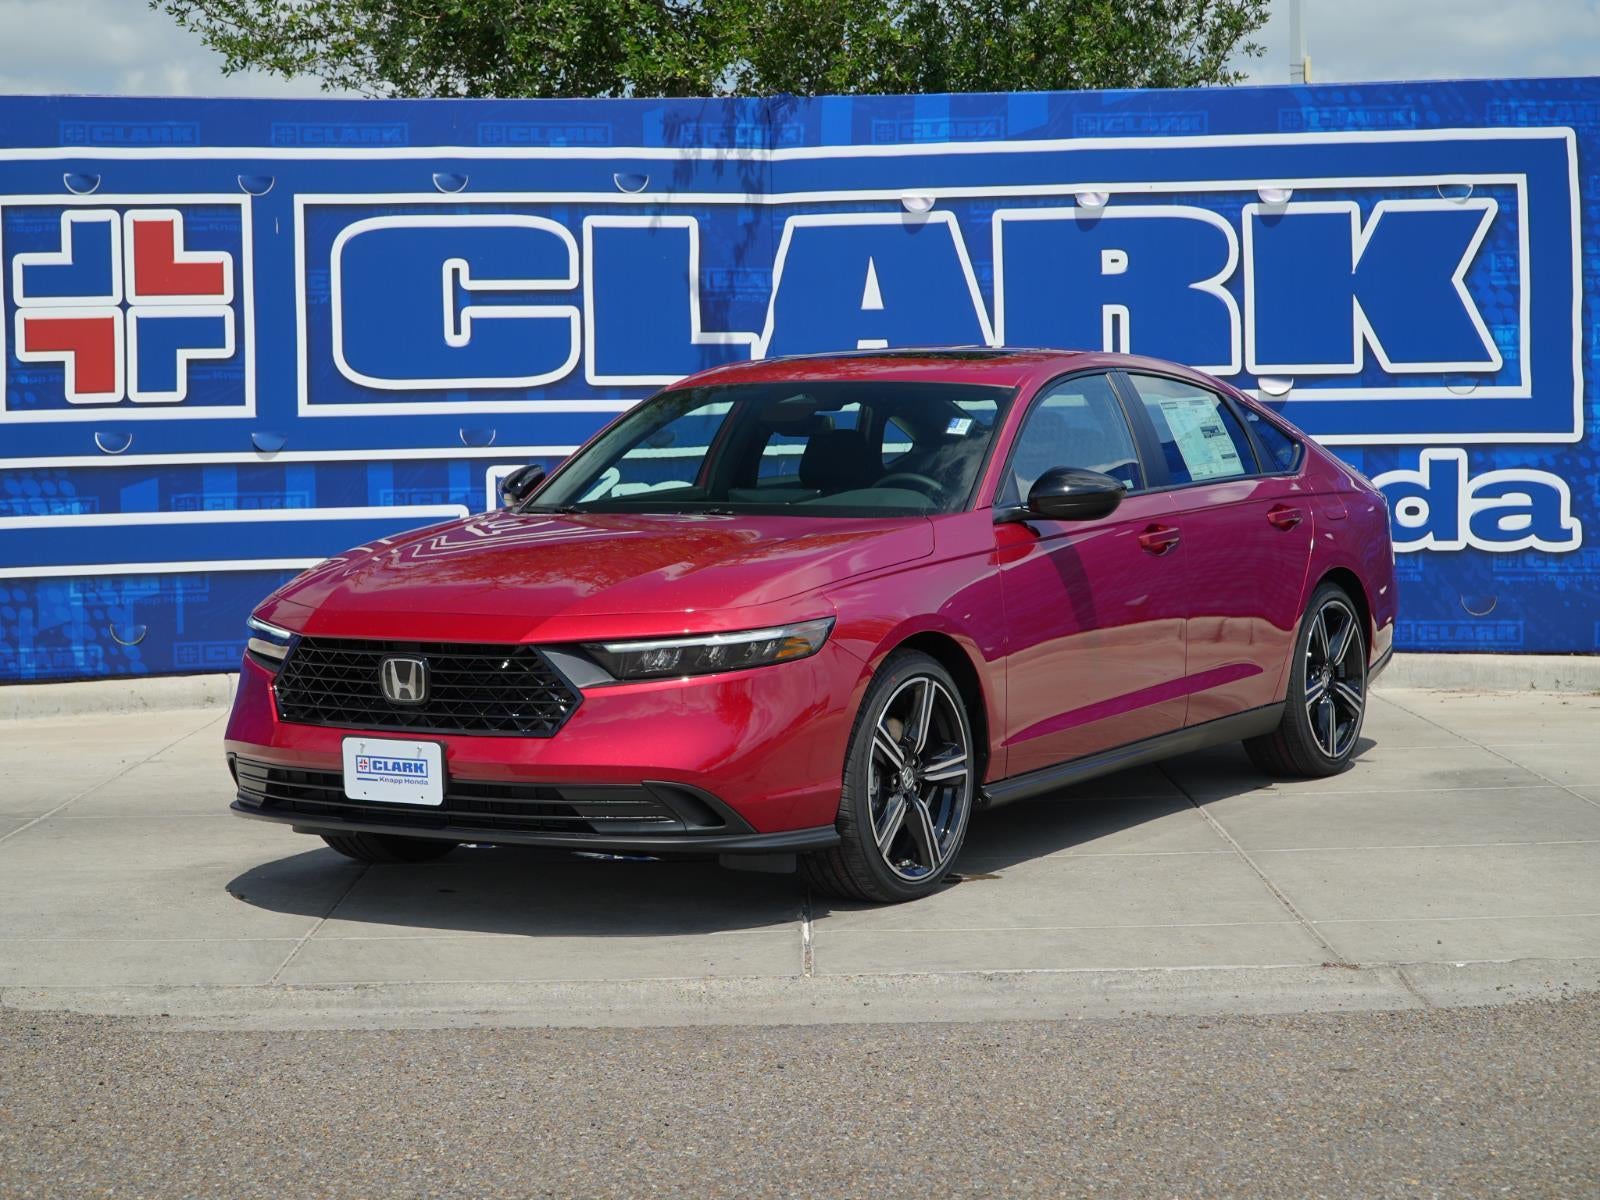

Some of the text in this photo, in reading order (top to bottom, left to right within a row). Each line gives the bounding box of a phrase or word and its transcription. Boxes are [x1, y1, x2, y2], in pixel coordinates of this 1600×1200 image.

[92, 127, 192, 141] CLARK
[303, 127, 401, 142] CLARK
[509, 127, 604, 141] CLARK
[331, 196, 1503, 391] CLARK
[1418, 625, 1516, 641] CLARK
[372, 760, 425, 773] CLARK
[379, 777, 403, 785] Knapp
